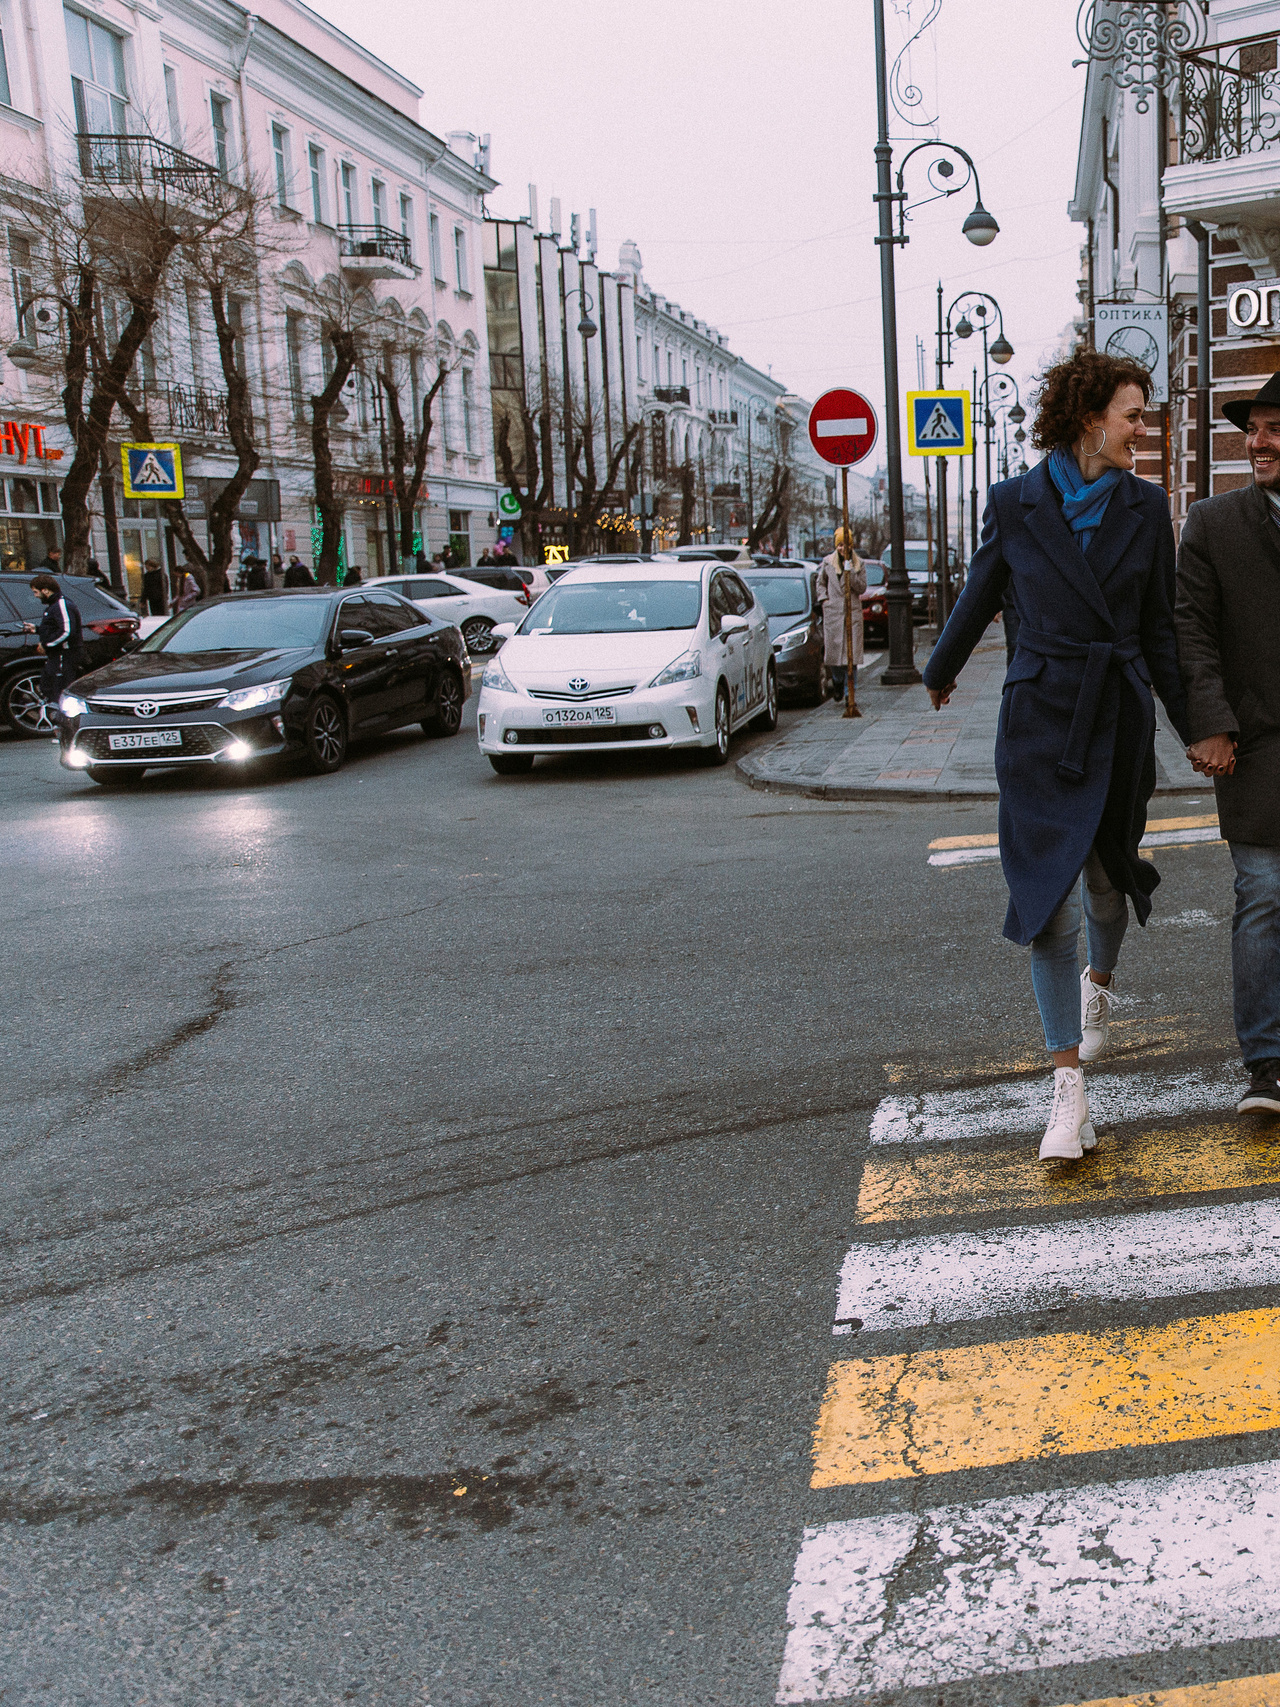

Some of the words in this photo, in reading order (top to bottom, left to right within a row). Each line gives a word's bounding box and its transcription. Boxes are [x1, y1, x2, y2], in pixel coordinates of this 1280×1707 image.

[1099, 310, 1162, 320] ОПТИКА
[545, 710, 593, 722] О132ОА
[594, 706, 612, 718] 125
[113, 735, 159, 748] Е337ЕЕ
[160, 732, 178, 742] 125
